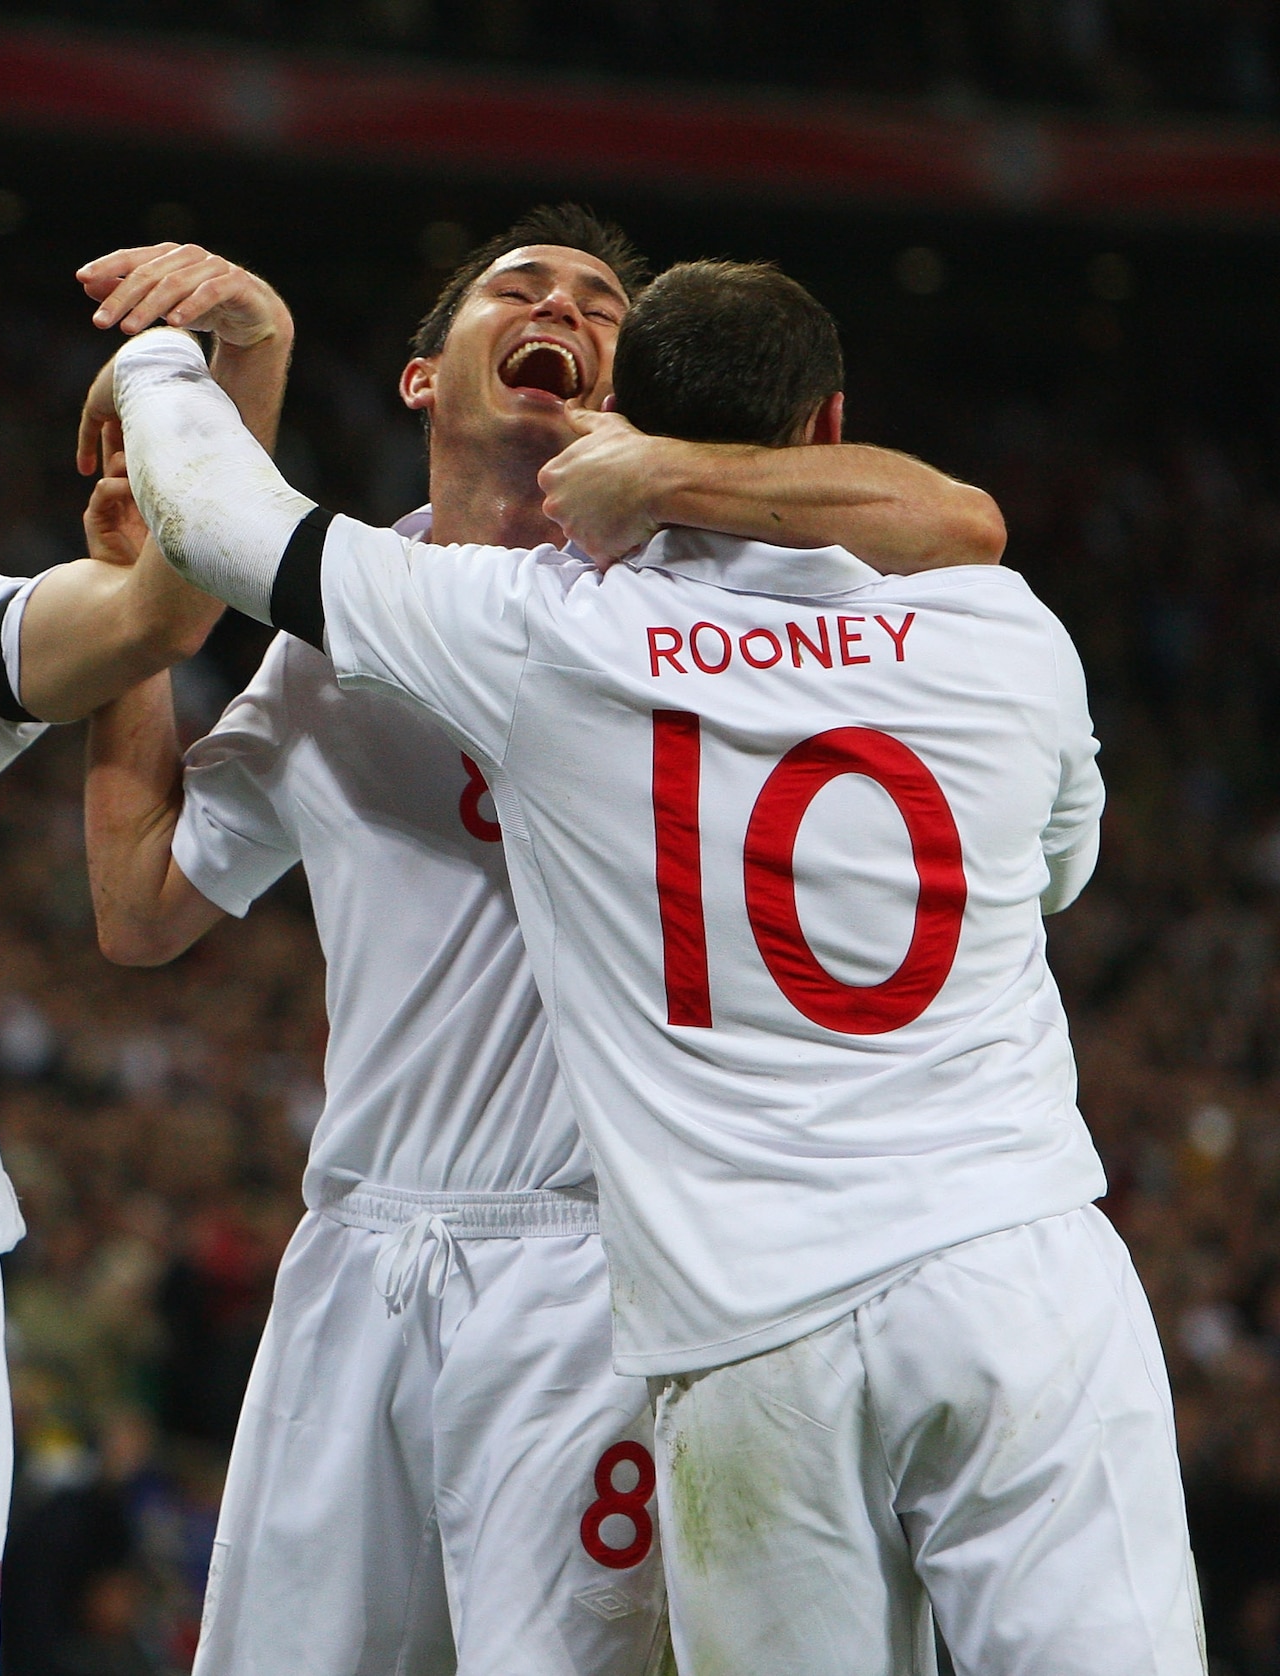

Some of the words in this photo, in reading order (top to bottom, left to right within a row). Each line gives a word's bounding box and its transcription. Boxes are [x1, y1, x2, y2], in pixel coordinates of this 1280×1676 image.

[646, 612, 915, 677] ROONEY
[652, 709, 967, 1035] 10
[580, 1440, 656, 1569] 8
